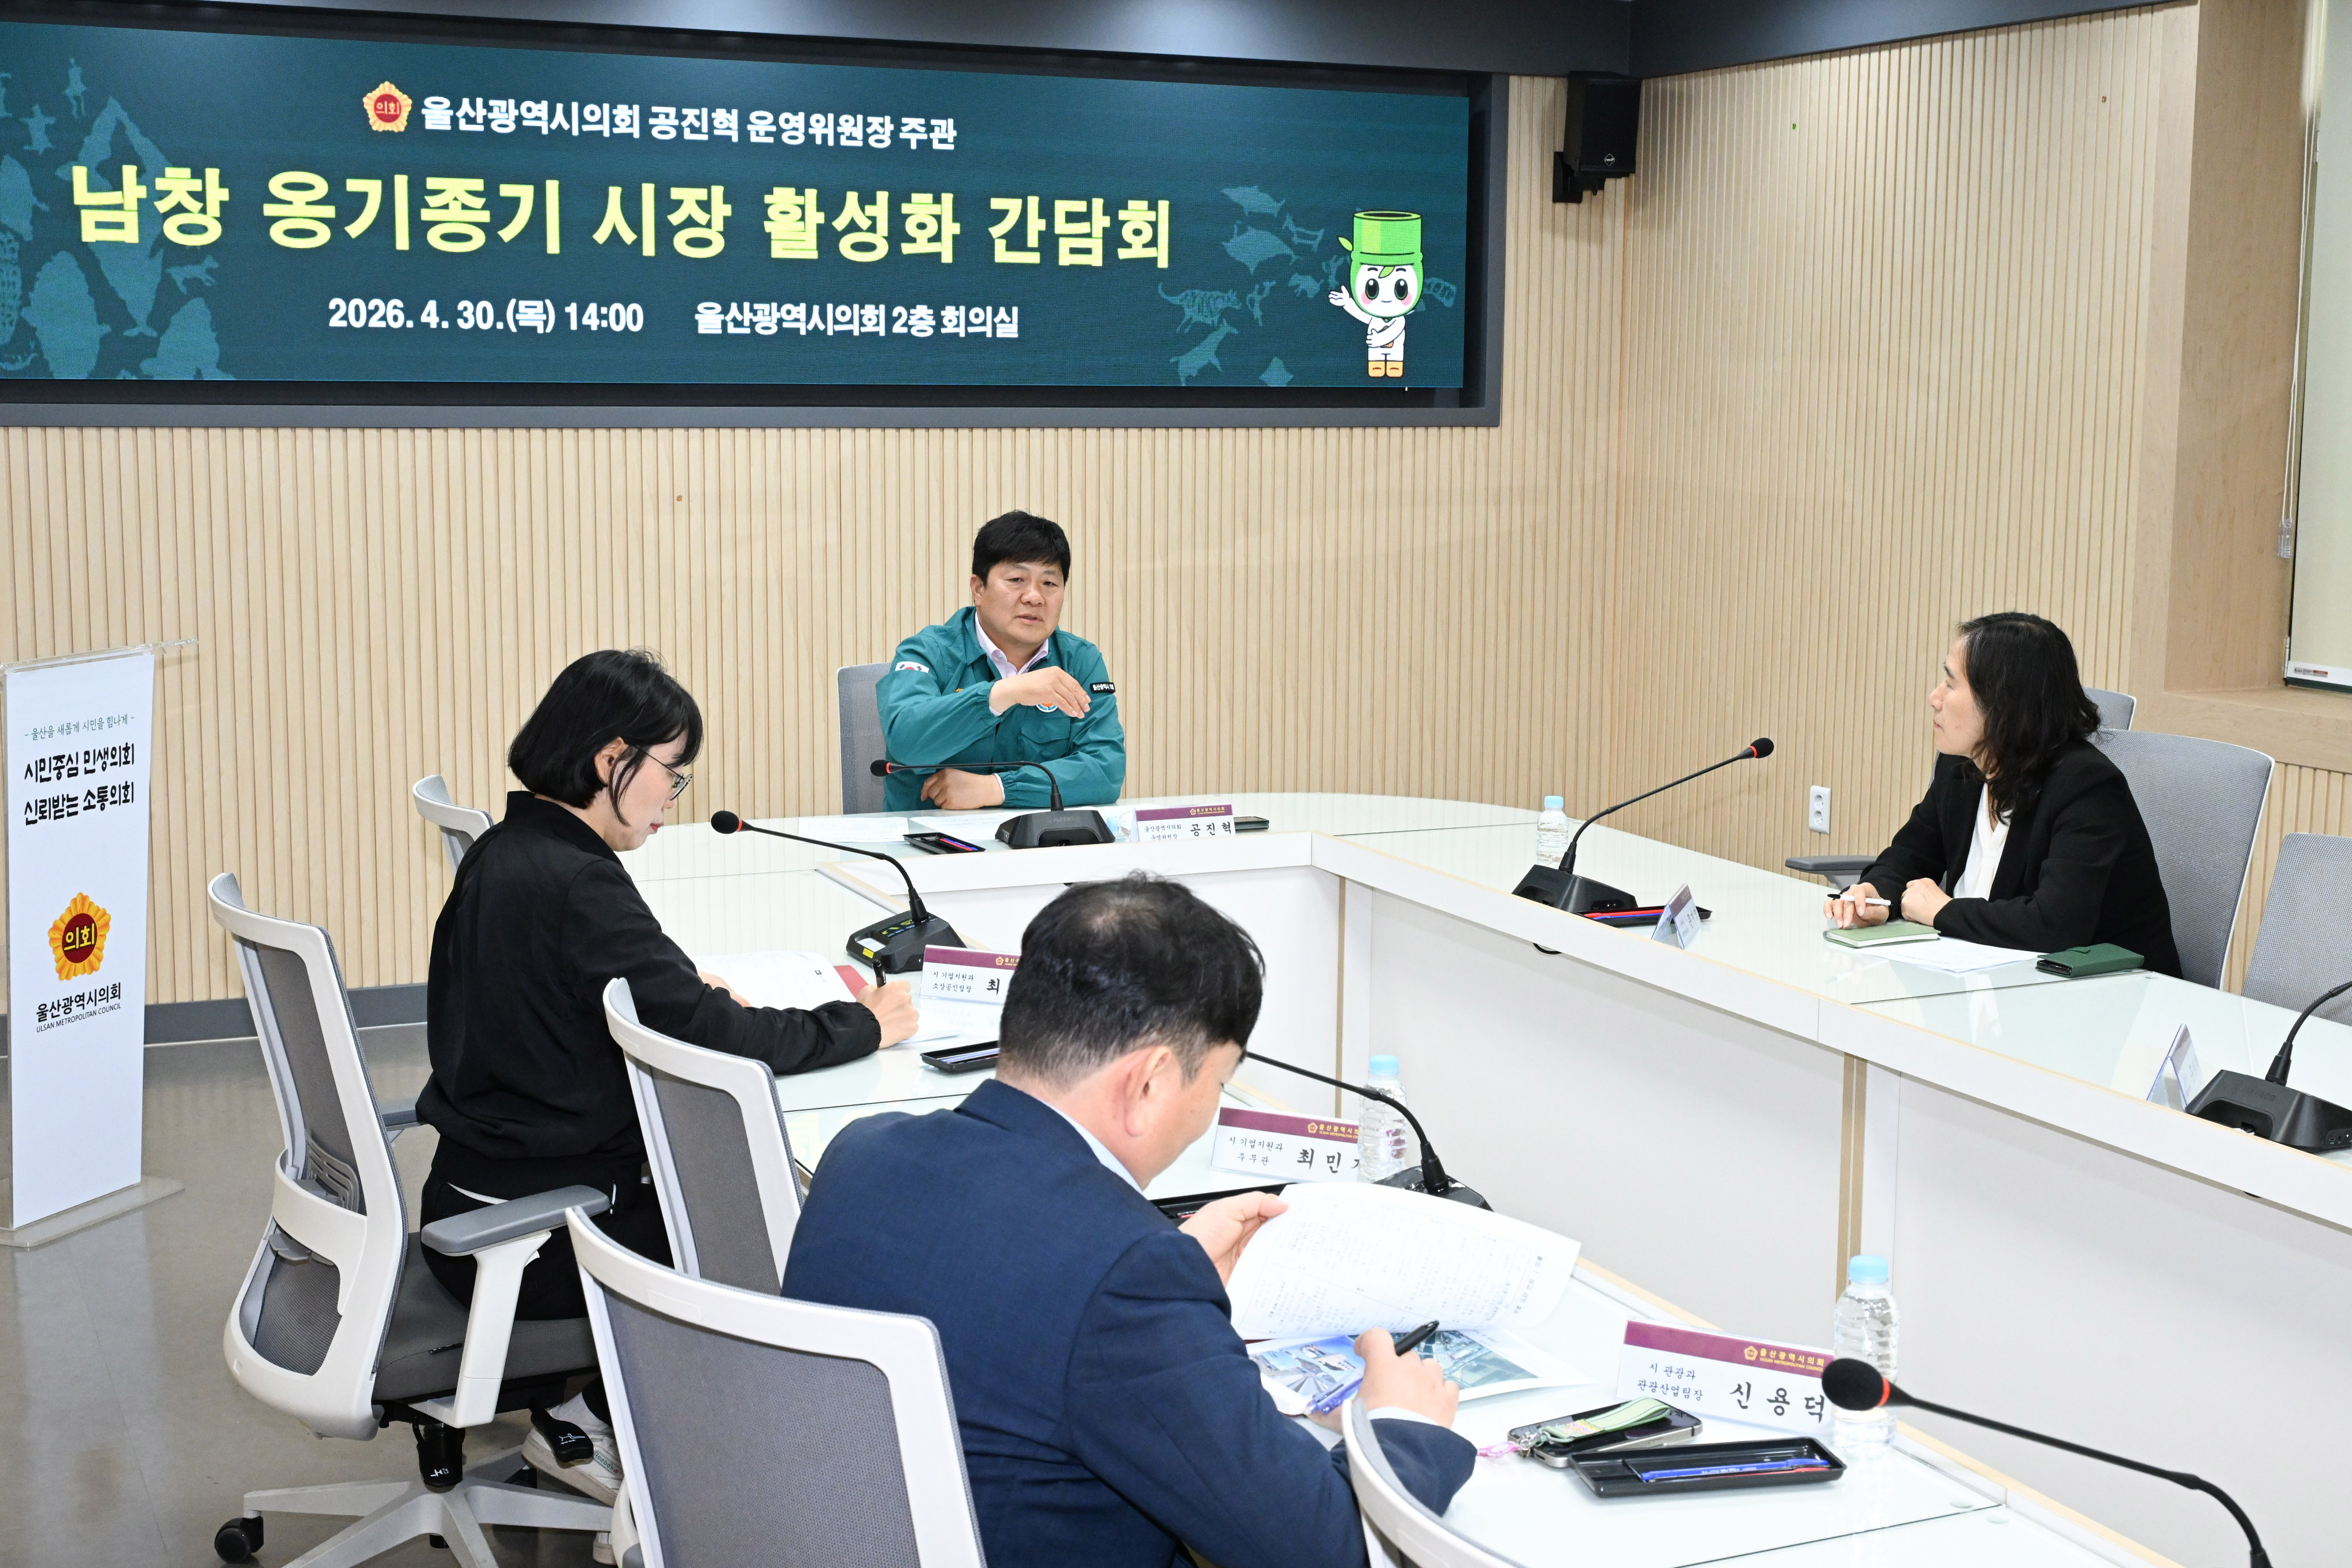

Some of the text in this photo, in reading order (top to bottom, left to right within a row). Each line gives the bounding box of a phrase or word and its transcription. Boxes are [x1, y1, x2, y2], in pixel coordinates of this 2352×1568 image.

[376, 100, 400, 114] 의회
[421, 96, 957, 150] 울산광역시의회 공진혁 운영위원장 주관
[72, 165, 1169, 269] 남창 옹기종기 시장 활성화 간담회
[328, 298, 413, 328] 2026.
[420, 300, 449, 329] 4.
[565, 302, 644, 332] 14:00
[695, 302, 886, 336] 울산광역시의회
[892, 305, 936, 338] 2층
[940, 305, 1018, 338] 회의실
[31, 725, 54, 740] 울산을
[57, 721, 79, 735] 새롭게
[82, 717, 104, 731] 시민을
[106, 713, 128, 728] 힘나게
[24, 742, 134, 783] 시민중심 민생의회
[24, 780, 134, 826] 신뢰받는 소통의회
[1144, 824, 1181, 833] 울산광역시의회
[64, 924, 95, 951] 의회
[942, 972, 975, 981] 기업지원과
[932, 983, 972, 993] 소상공인팀장
[36, 982, 121, 1023] 울산광역시의회
[36, 1003, 121, 1033] ULSAN METROPOLITAN COUNCIL
[1319, 1124, 1359, 1136] 울산광역시의
[1229, 1136, 1283, 1152] 시 기업지원과
[1760, 1348, 1824, 1367] 울산광역시의회
[1649, 1363, 1696, 1381] 시 관광과
[1637, 1379, 1703, 1401] 관광산업팀장
[593, 1451, 614, 1471] Reebok
